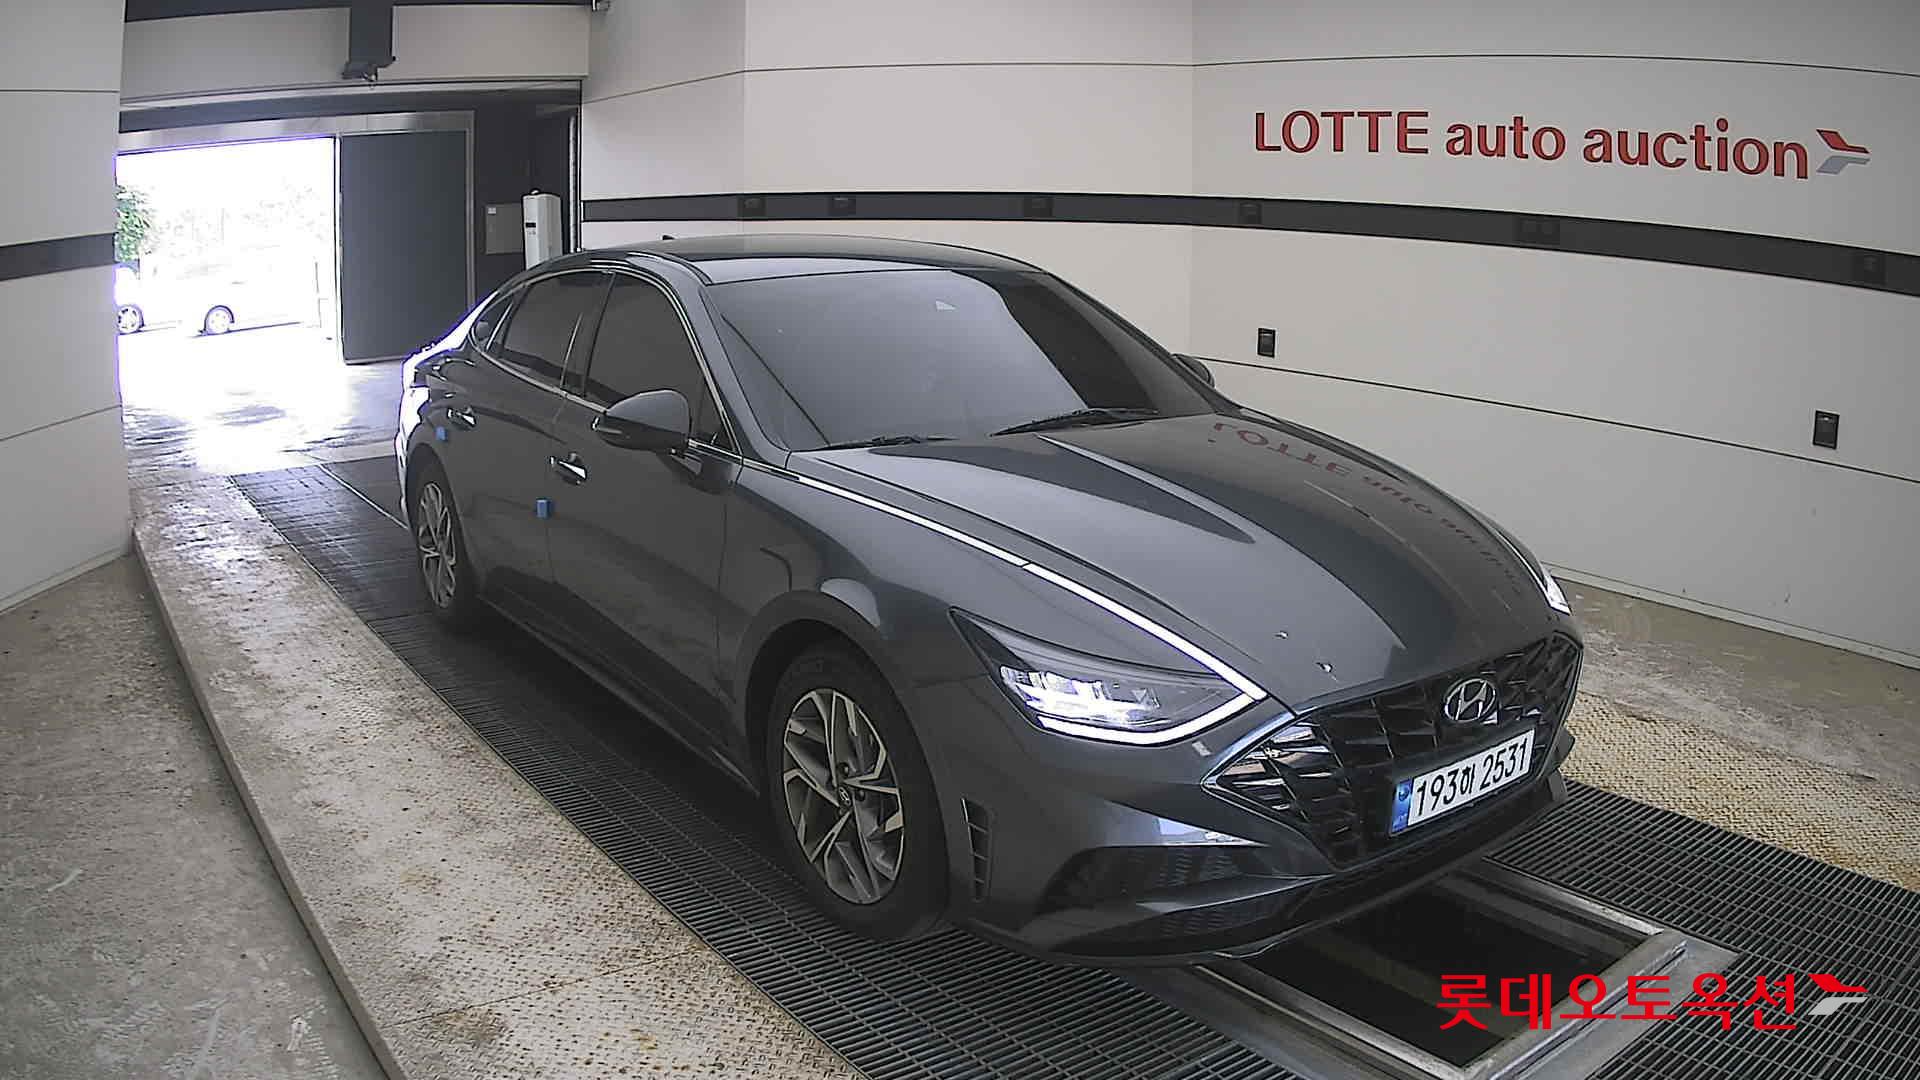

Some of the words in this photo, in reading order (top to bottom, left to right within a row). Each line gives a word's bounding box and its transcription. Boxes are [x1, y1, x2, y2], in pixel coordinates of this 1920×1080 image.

[1255, 110, 1430, 154] LOTTE
[1445, 115, 1567, 160] auto
[1582, 117, 1809, 178] auction
[1479, 738, 1528, 790] 2531
